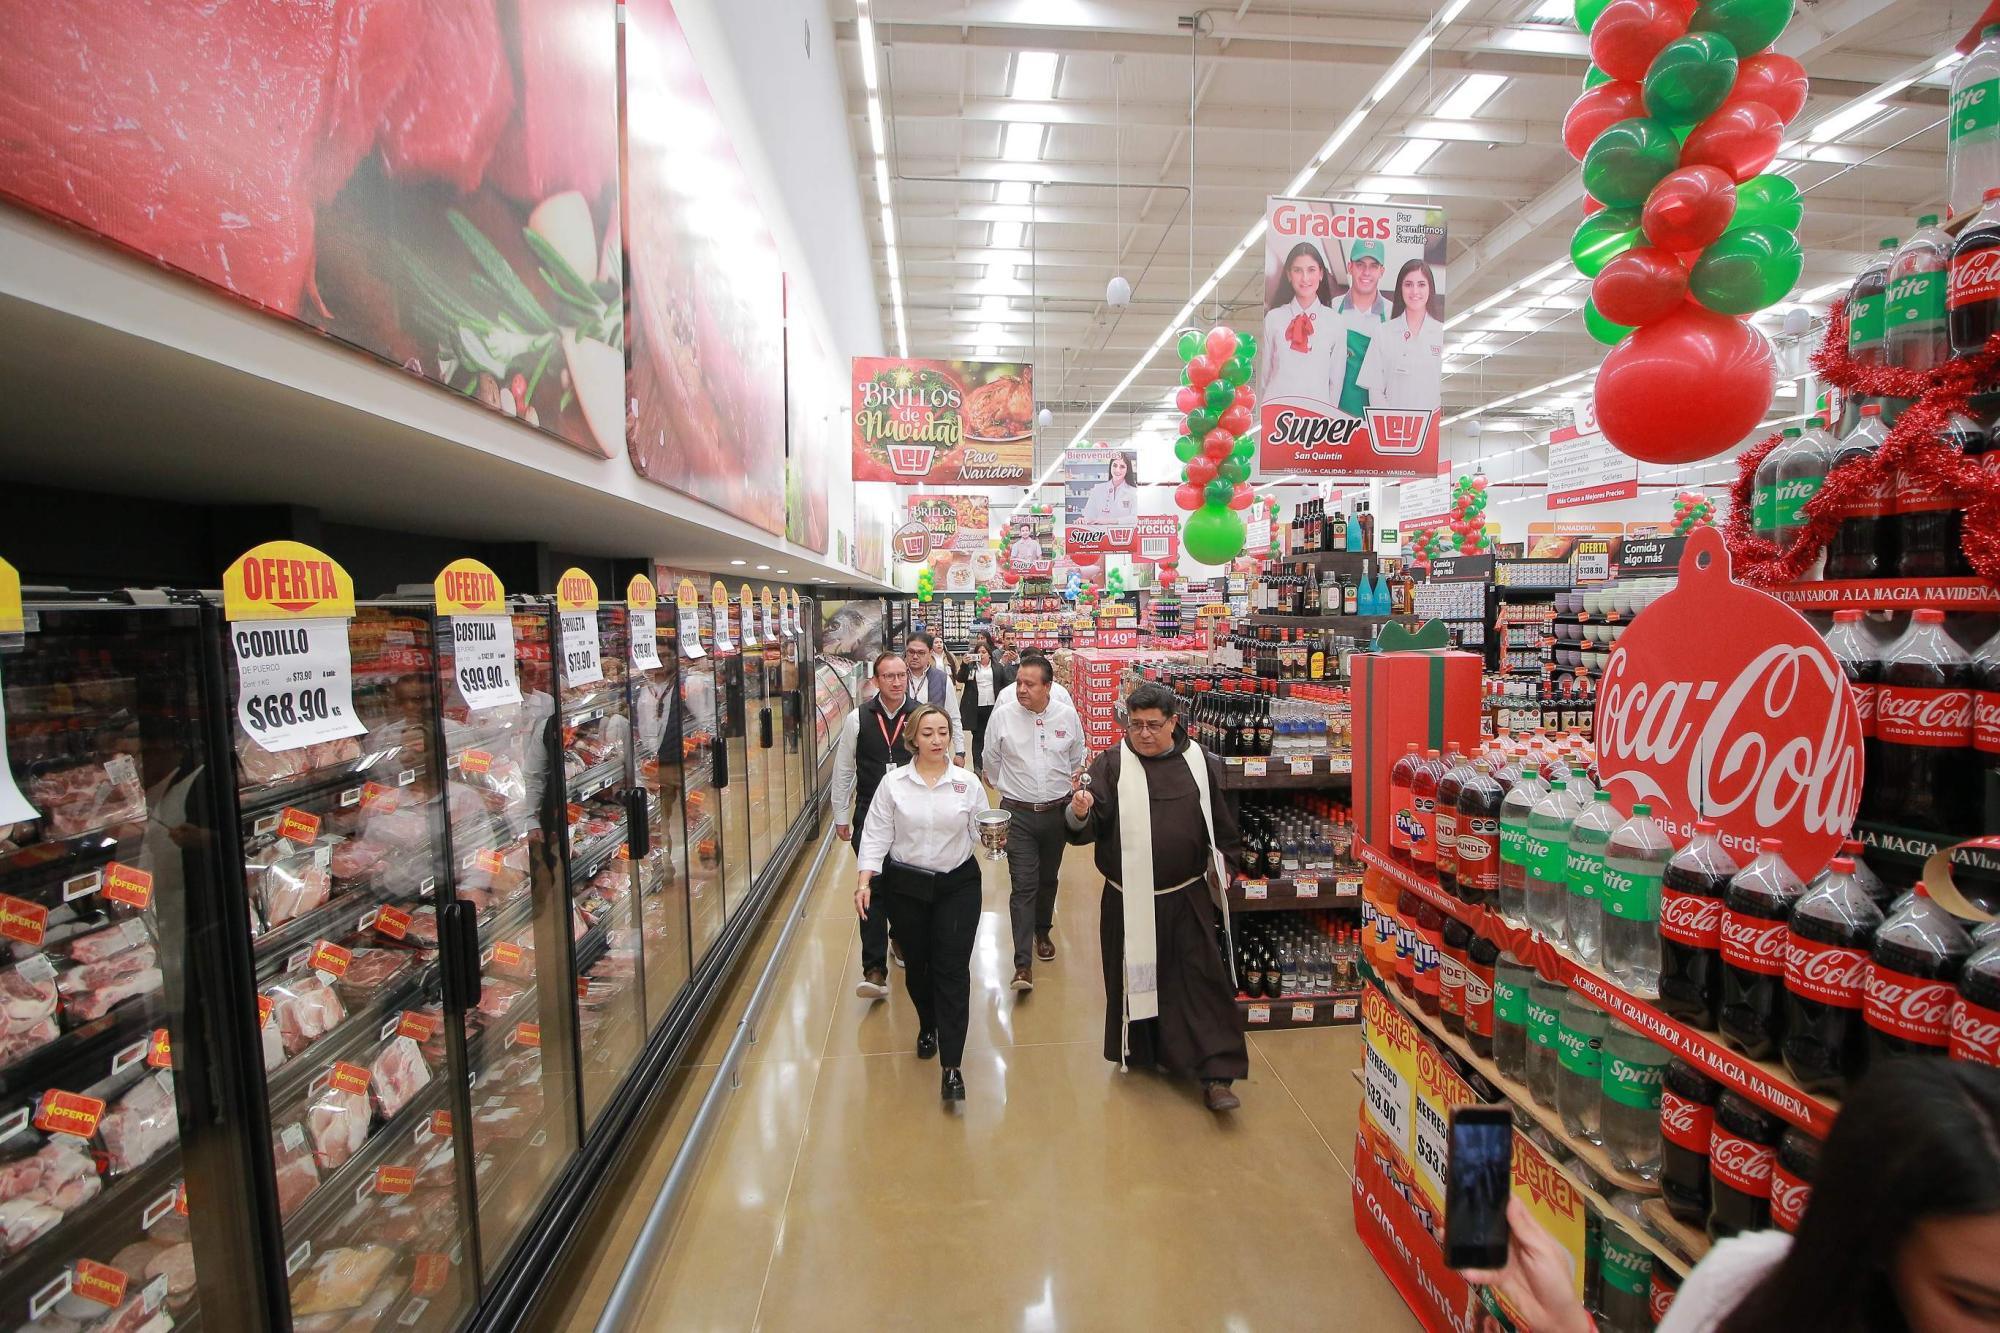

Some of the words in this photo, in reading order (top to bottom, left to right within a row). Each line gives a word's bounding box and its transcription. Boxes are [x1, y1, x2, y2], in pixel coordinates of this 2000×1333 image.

[1273, 205, 1391, 239] Gracias
[1396, 212, 1411, 222] Por
[1396, 224, 1444, 235] permitirnos
[1396, 234, 1428, 245] Servirle
[858, 382, 962, 409] BRILLOS
[900, 408, 920, 422] de
[855, 410, 965, 446] Navidad
[1269, 411, 1362, 447] Super
[963, 450, 998, 464] Pavo
[1067, 451, 1122, 460] Bienvenidos
[1294, 451, 1311, 460] San
[1311, 451, 1343, 461] Quintín
[957, 463, 1024, 480] Navideño
[1585, 493, 1605, 501] Mejores
[1606, 489, 1625, 498] Precios
[911, 505, 957, 517] BRILLOS
[1137, 519, 1167, 527] erificador
[1168, 519, 1174, 527] de
[1069, 529, 1105, 544] Super
[1579, 542, 1608, 553] OFERTA
[1625, 543, 1657, 554] Comida
[1659, 544, 1666, 554] y
[1433, 560, 1451, 568] Comida
[1624, 554, 1643, 566] algo
[1645, 553, 1663, 563] más
[243, 556, 338, 601] OFERTA
[1433, 568, 1443, 576] algo
[1579, 566, 1603, 574] $138.90
[444, 570, 496, 601] OFERTA
[562, 577, 592, 601] OFERTA
[631, 582, 652, 600] OFERTA
[1783, 590, 1806, 602] GRAN
[1806, 589, 1839, 602] SABOR
[1843, 589, 1852, 601] A
[1855, 588, 1871, 600] LA
[1874, 587, 1920, 601] MAGIA
[1925, 584, 2000, 600] NAVIDEÑA
[1105, 607, 1130, 615] OFERTA
[1202, 606, 1226, 614] OFERTA
[455, 622, 496, 642] COSTILLA
[561, 617, 586, 633] CHULETA
[236, 628, 309, 659] CODILLO
[568, 650, 591, 673] $79.90
[292, 671, 312, 682] $73.90
[460, 665, 503, 694] $99.90
[246, 687, 329, 733] $68.90
[331, 706, 341, 717] KG
[1598, 643, 1857, 837] Coca-Cola
[1886, 727, 1914, 735] SABOR
[1917, 729, 1964, 737] ORIGINAL
[288, 820, 316, 835] OFERTA
[1858, 830, 1878, 847] LA
[1882, 834, 1938, 857] MAGIA
[115, 879, 147, 895] OFERTA
[5, 913, 42, 930] OFERTA
[383, 916, 407, 930] OFERTA
[1665, 925, 1699, 938] ORIGINAL
[320, 952, 347, 968] OFERTA
[1414, 941, 1441, 965] NTA
[1726, 948, 1750, 960] SABOR
[1803, 981, 1851, 998] ORIGINAL
[1369, 995, 1411, 1047] Oferta
[1868, 1007, 1895, 1025] SABOR
[406, 1021, 430, 1034] OFERTA
[1572, 973, 1608, 1004] AGREGA
[1609, 993, 1622, 1010] UN
[1622, 1002, 1648, 1024] GRAN
[1647, 1017, 1680, 1047] SABOR
[1681, 1037, 1691, 1052] A
[1691, 1044, 1705, 1063] LA
[1707, 1051, 1747, 1087] MAGIA
[1749, 1076, 1813, 1123] NAVIDEÑA
[1366, 1043, 1398, 1089] REFRESCO
[340, 1074, 367, 1087] OFERTA
[1419, 1050, 1474, 1107] Oferta
[1366, 1076, 1397, 1127] $33.90
[53, 1107, 96, 1124] OFERTA
[1417, 1095, 1448, 1142] REFRES
[1417, 1134, 1448, 1185] $33.9
[385, 1175, 413, 1186] OFERTA
[1366, 1192, 1412, 1265] comer
[1601, 1237, 1652, 1273] Sprite
[85, 1276, 122, 1294] OFERTA
